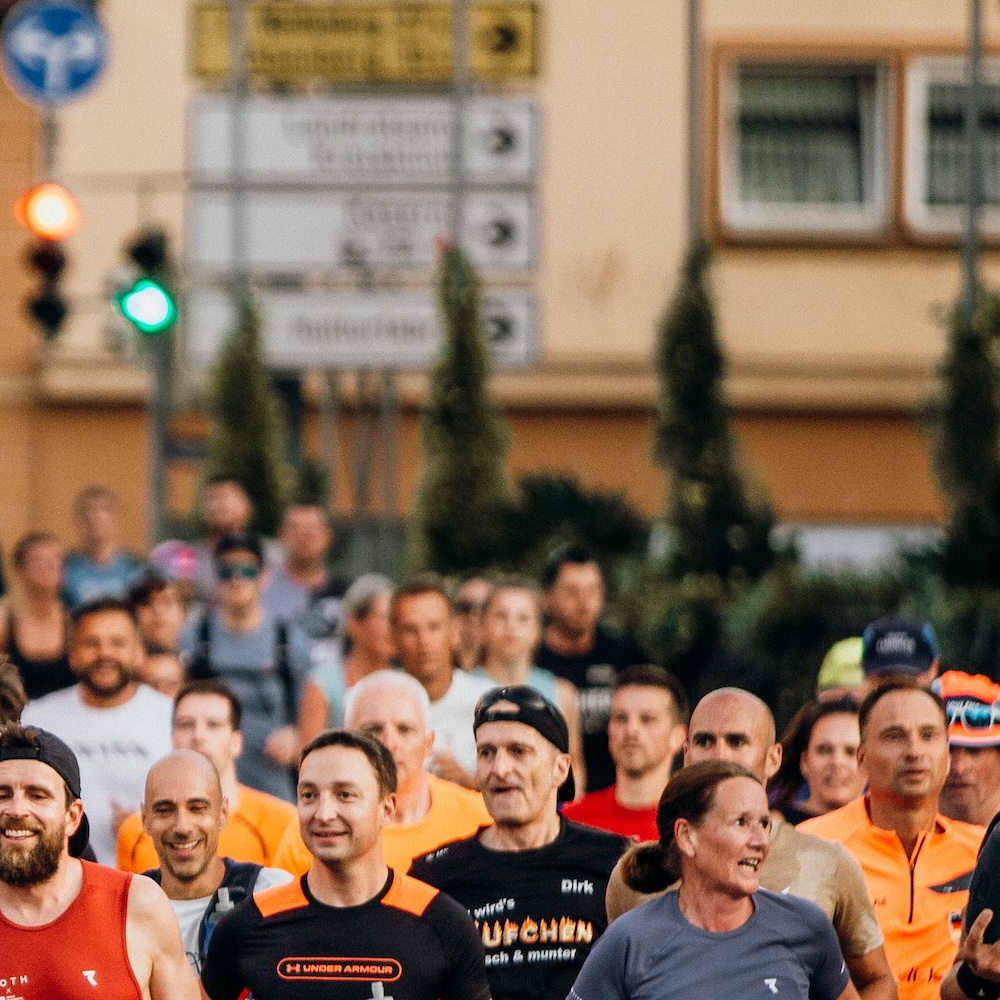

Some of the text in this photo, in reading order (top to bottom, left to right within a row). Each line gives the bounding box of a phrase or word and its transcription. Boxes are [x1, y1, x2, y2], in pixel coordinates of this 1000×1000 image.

[561, 879, 594, 895] Dirk
[474, 898, 515, 919] wird's
[474, 915, 593, 948] UFCHEN
[513, 949, 524, 963] &
[528, 947, 577, 962] munter
[303, 964, 393, 975] UNDER ARMOUR
